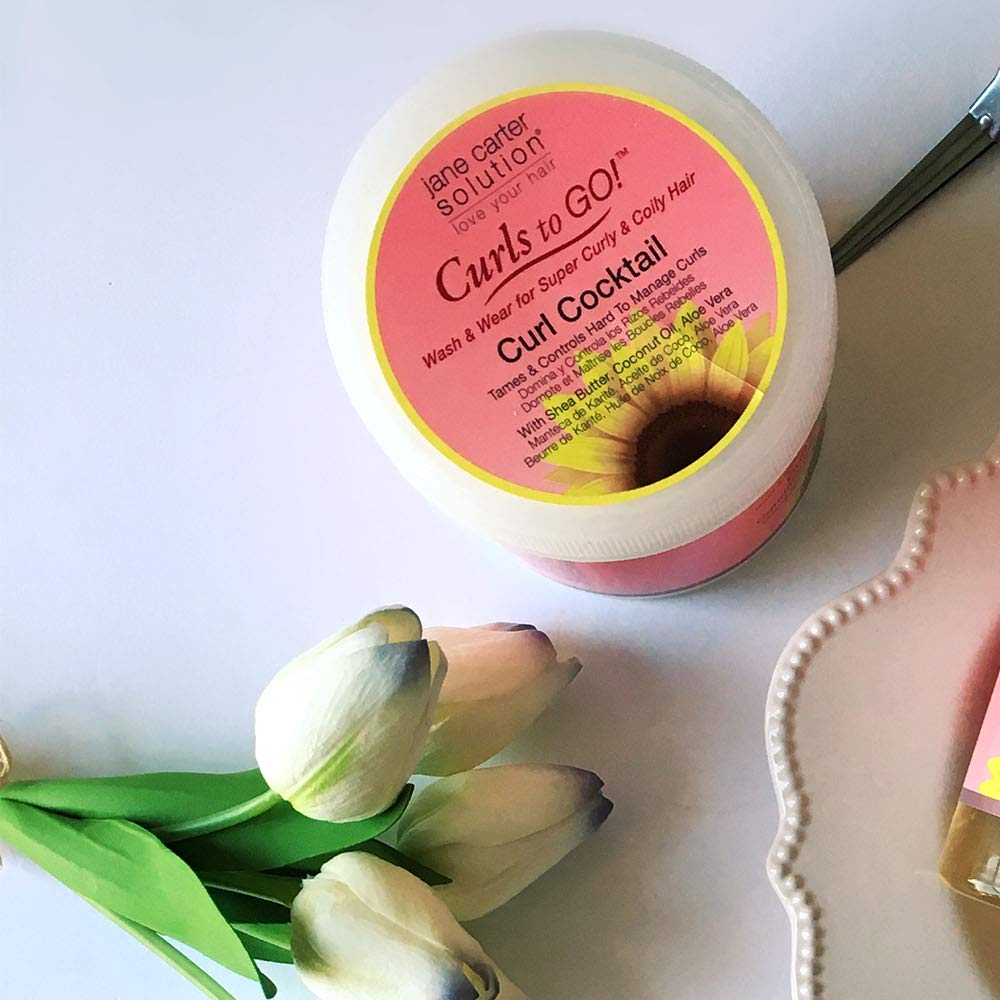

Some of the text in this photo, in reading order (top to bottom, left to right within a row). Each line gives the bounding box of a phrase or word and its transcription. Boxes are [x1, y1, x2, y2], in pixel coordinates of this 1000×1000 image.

[420, 112, 529, 200] jane carter
[421, 172, 695, 369] Wash & Wear for Super Curly & Coily Hair
[435, 221, 532, 302] Curls
[535, 212, 562, 243] to
[486, 245, 708, 400] Tames & Controls Hard To Manage Curls
[496, 233, 668, 363] Curl Cocktail
[515, 416, 547, 438] With
[544, 396, 577, 421] Shea
[611, 335, 662, 375] Coconut
[680, 305, 707, 328] Aloe
[703, 286, 733, 308] Vera
